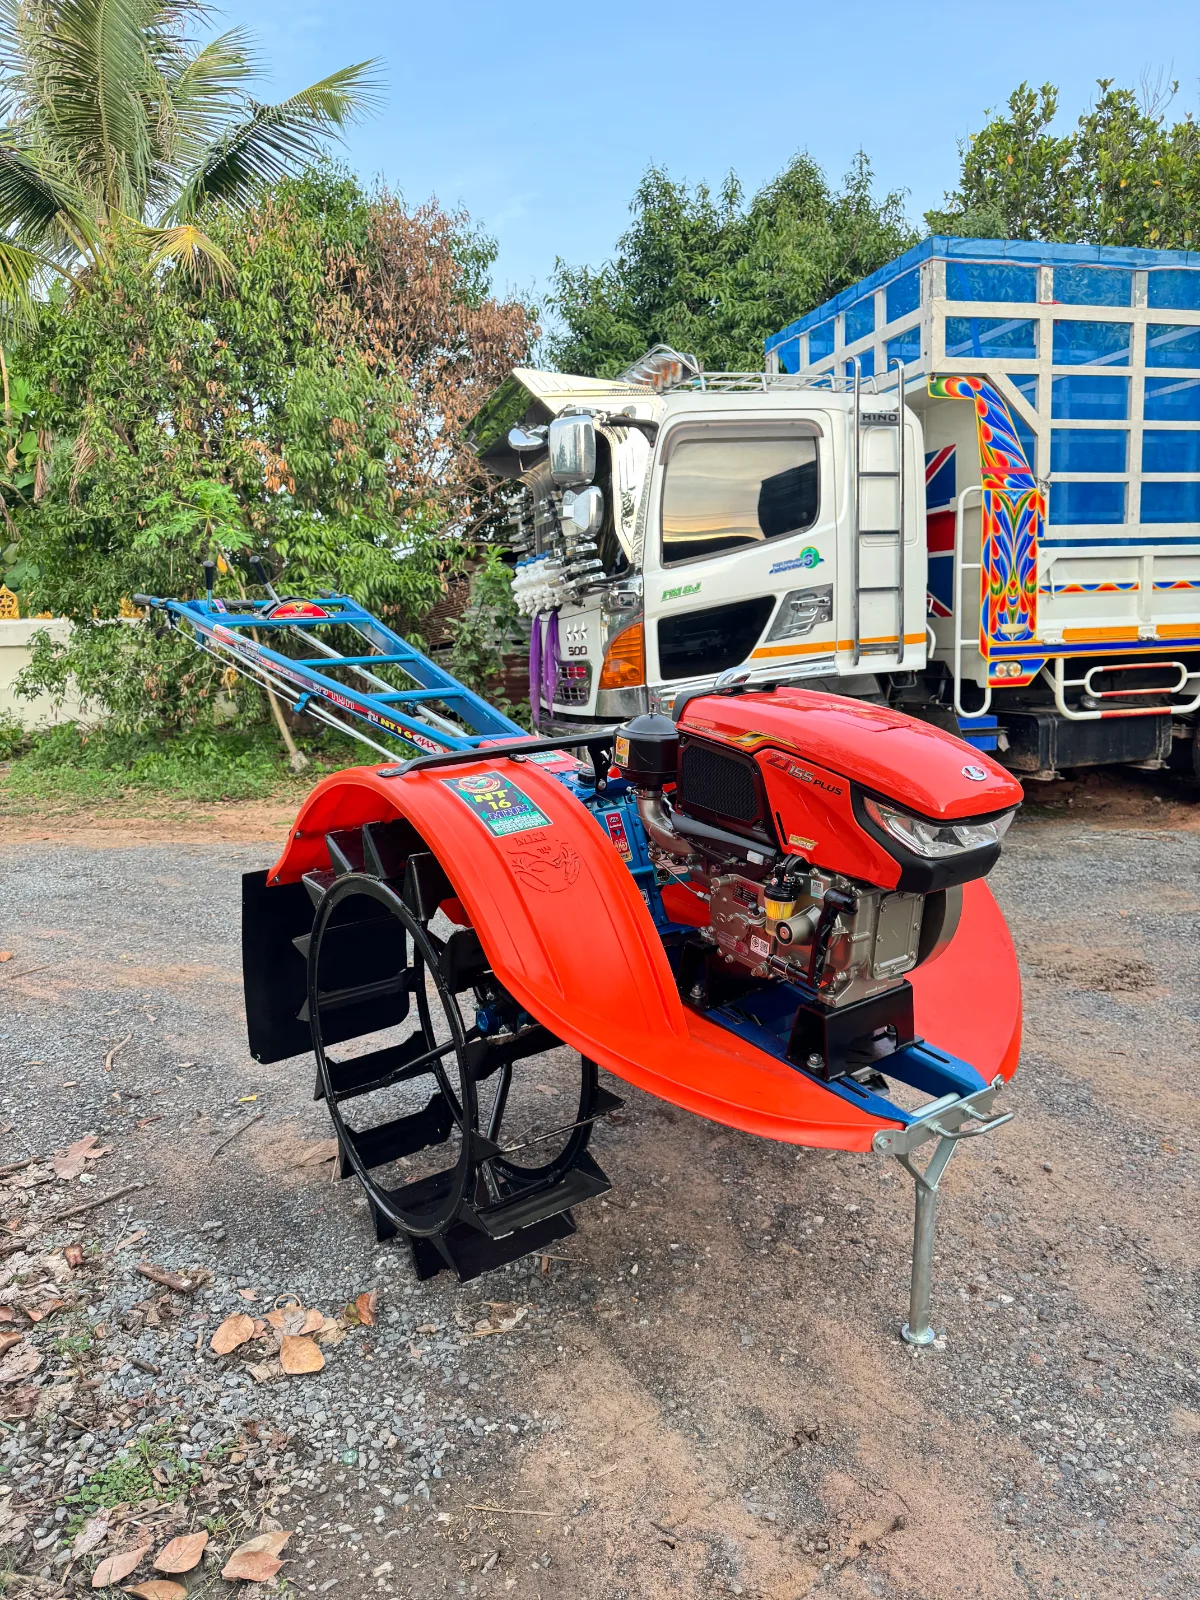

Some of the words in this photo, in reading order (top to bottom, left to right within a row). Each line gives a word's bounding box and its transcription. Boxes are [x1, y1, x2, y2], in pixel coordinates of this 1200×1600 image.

[568, 645, 588, 656] 500
[380, 717, 413, 739] NT16
[416, 736, 438, 752] MAX
[813, 779, 843, 796] PLUS
[474, 789, 509, 803] NT
[488, 799, 512, 811] 16
